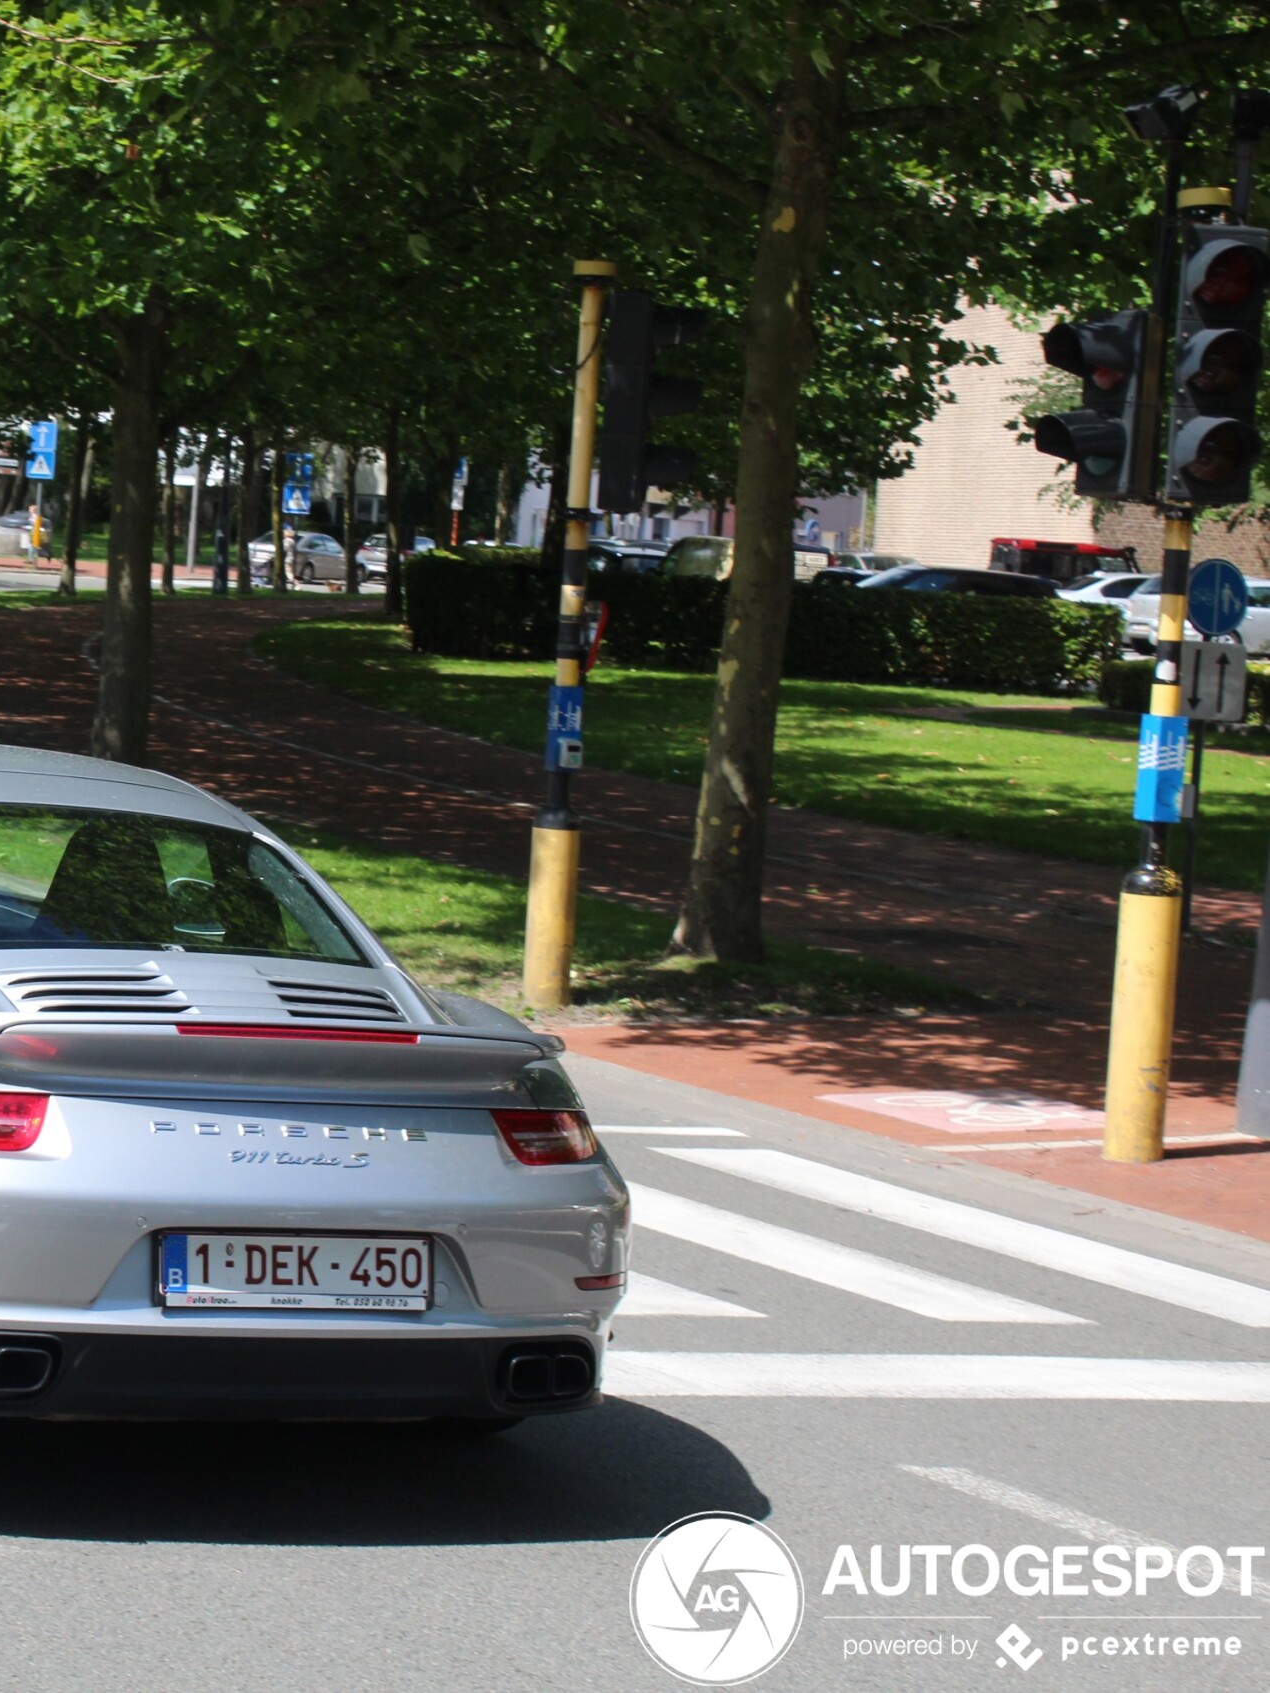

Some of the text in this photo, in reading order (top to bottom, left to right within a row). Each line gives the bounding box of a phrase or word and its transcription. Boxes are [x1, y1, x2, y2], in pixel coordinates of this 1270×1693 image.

[150, 1120, 427, 1142] PORSCHE
[229, 1150, 370, 1168] 911 turbo S
[169, 1268, 183, 1287] B
